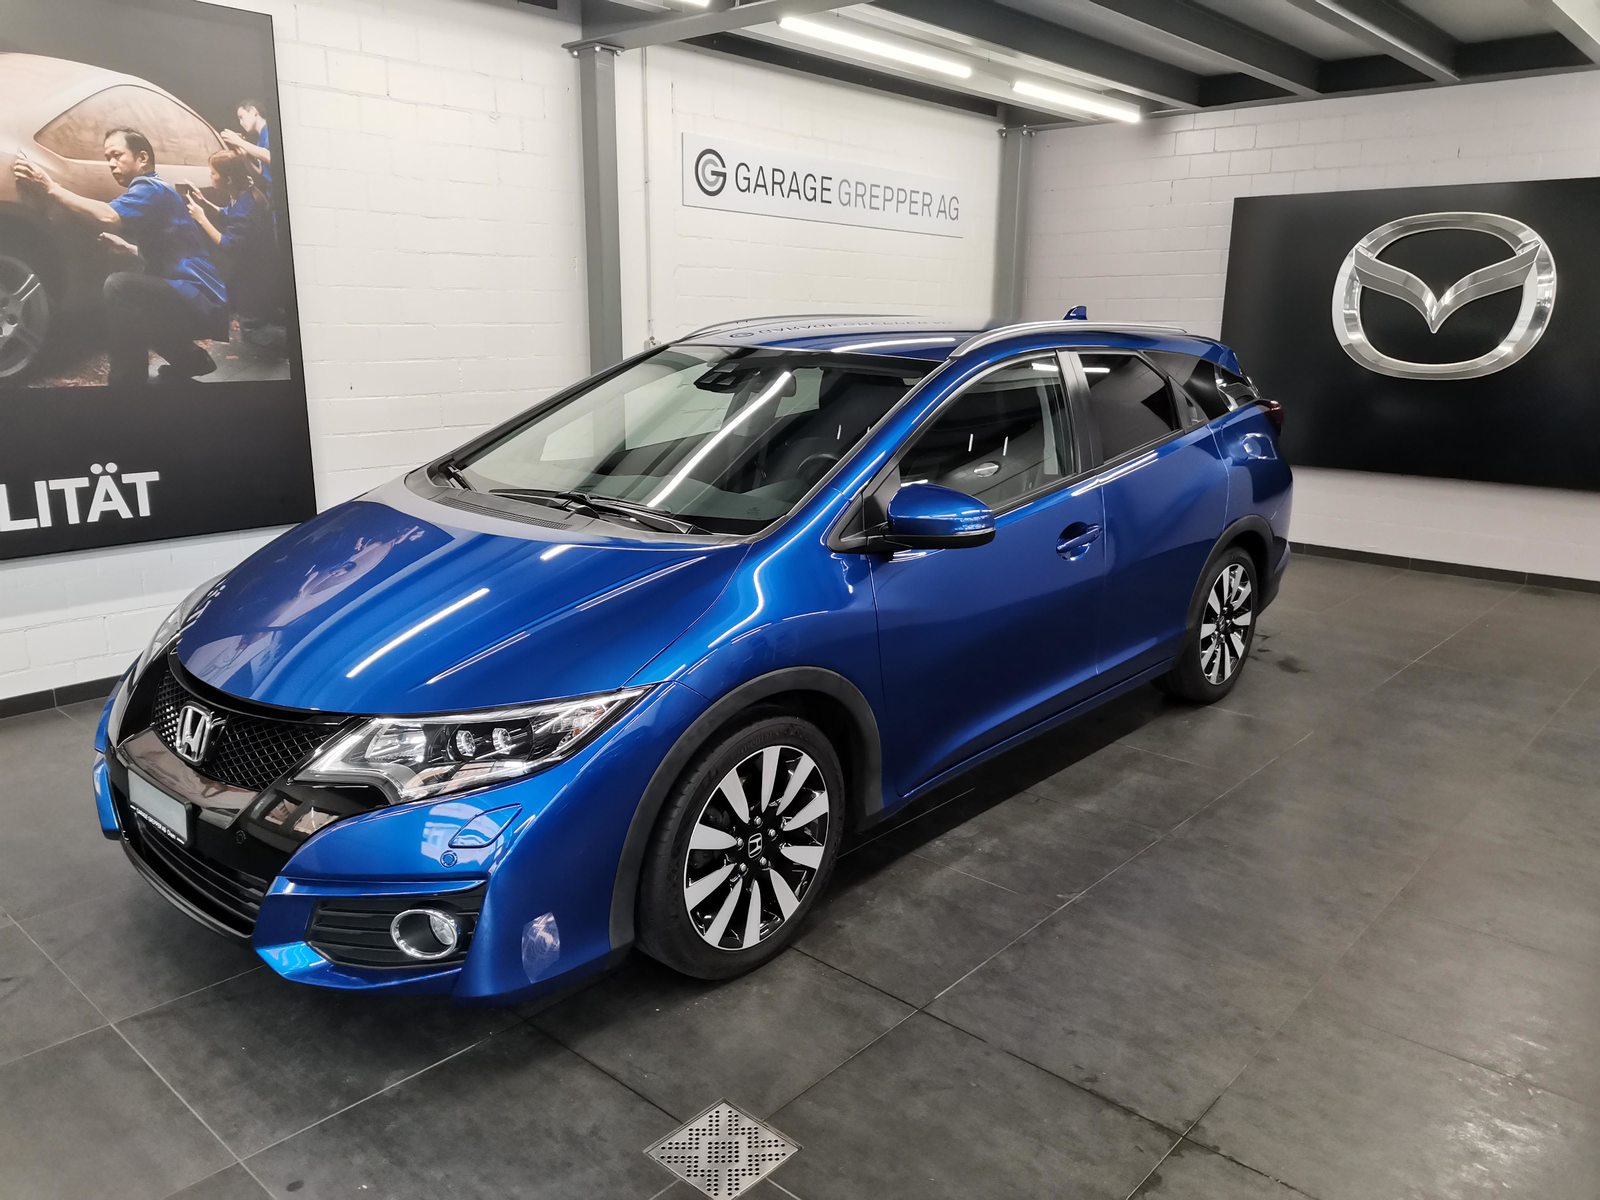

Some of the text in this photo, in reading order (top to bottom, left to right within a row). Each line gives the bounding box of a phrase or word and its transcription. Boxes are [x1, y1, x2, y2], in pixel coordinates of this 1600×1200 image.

[734, 162, 833, 204] GARAGE
[838, 178, 932, 217] GREPPER
[936, 194, 960, 221] AG
